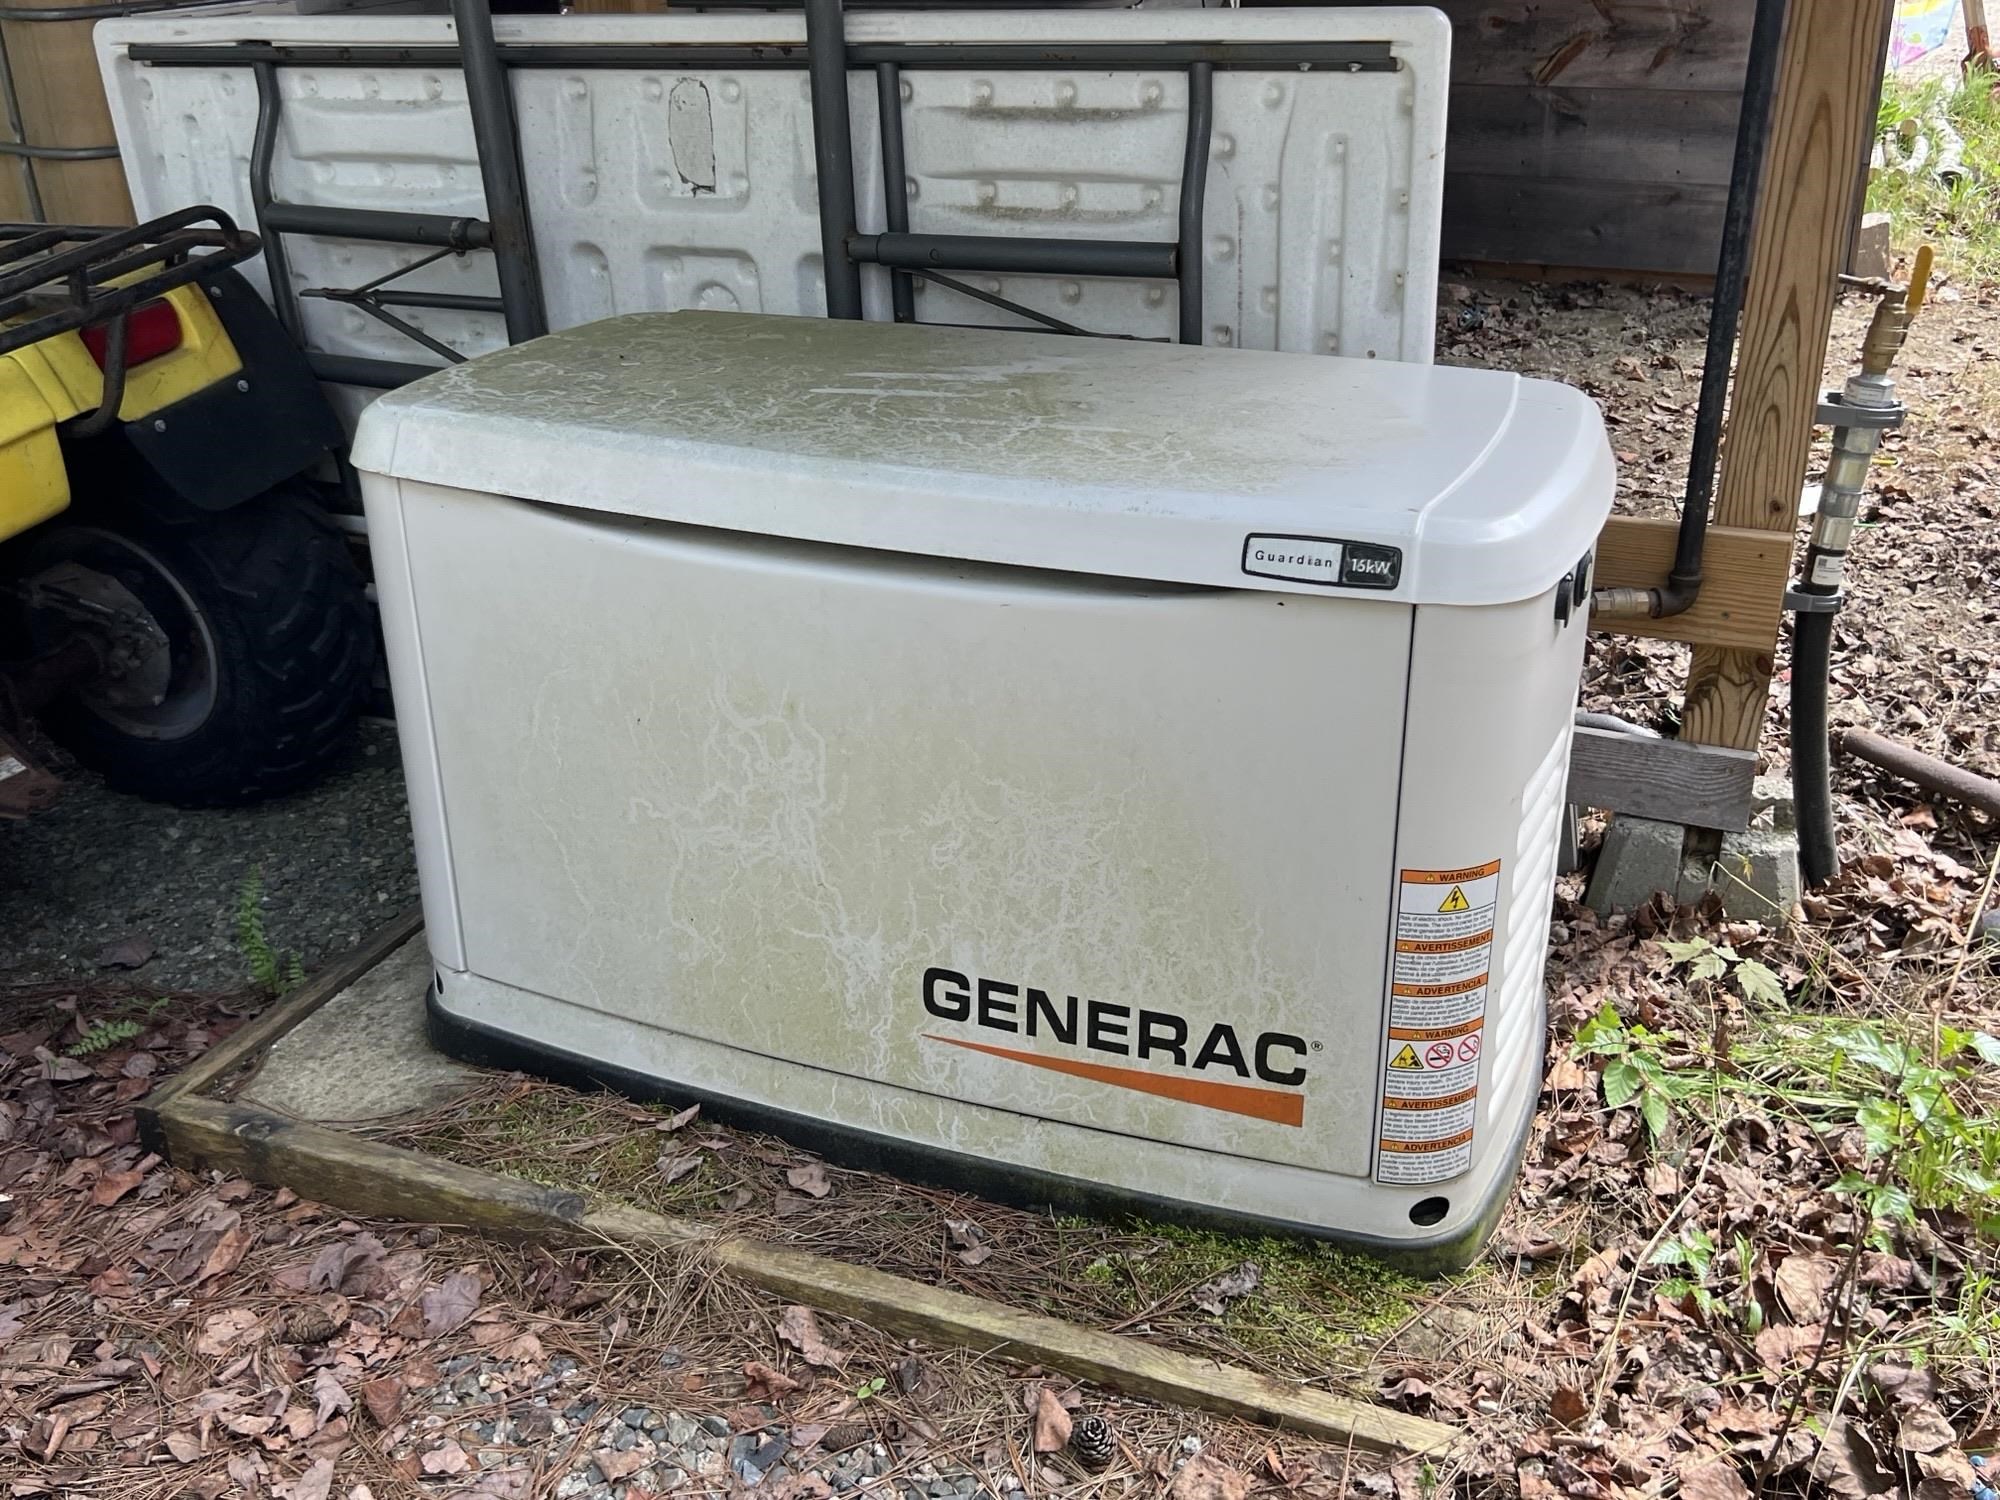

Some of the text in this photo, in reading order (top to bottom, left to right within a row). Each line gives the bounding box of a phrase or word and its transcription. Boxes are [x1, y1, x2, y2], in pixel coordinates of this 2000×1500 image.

[1255, 550, 1333, 568] Guardian
[1439, 868, 1485, 882] WARNING
[1414, 932, 1490, 951] AVERTISSEMENT
[1416, 978, 1481, 995] ADVERTENCIA
[1425, 1025, 1469, 1039] WARNING
[1401, 1090, 1475, 1109] AVERTISSEMENT
[1403, 1134, 1466, 1151] ADVERTENCIA
